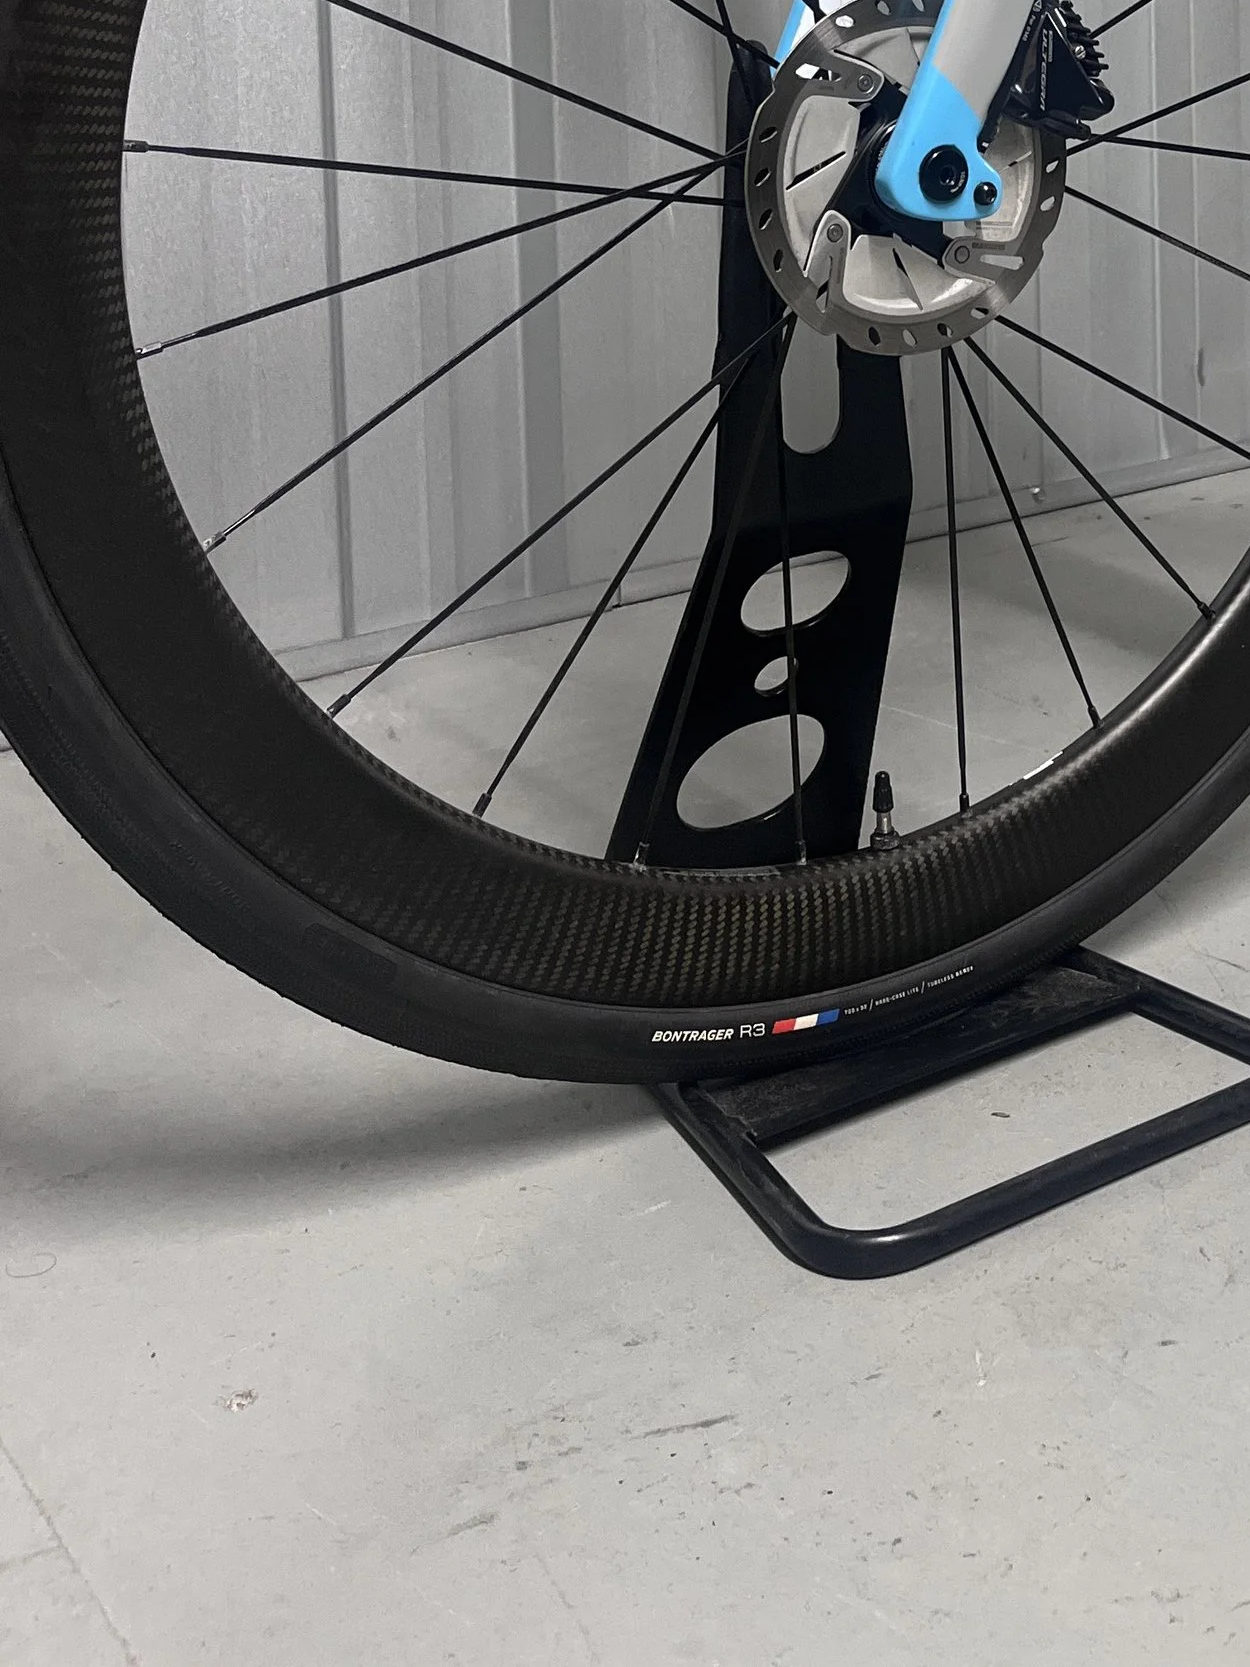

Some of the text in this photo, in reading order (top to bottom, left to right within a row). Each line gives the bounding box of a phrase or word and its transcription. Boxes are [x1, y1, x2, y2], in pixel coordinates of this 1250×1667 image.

[1040, 28, 1049, 112] ULTEGRA
[651, 1028, 734, 1042] BONTRAGER
[740, 1022, 766, 1039] R3
